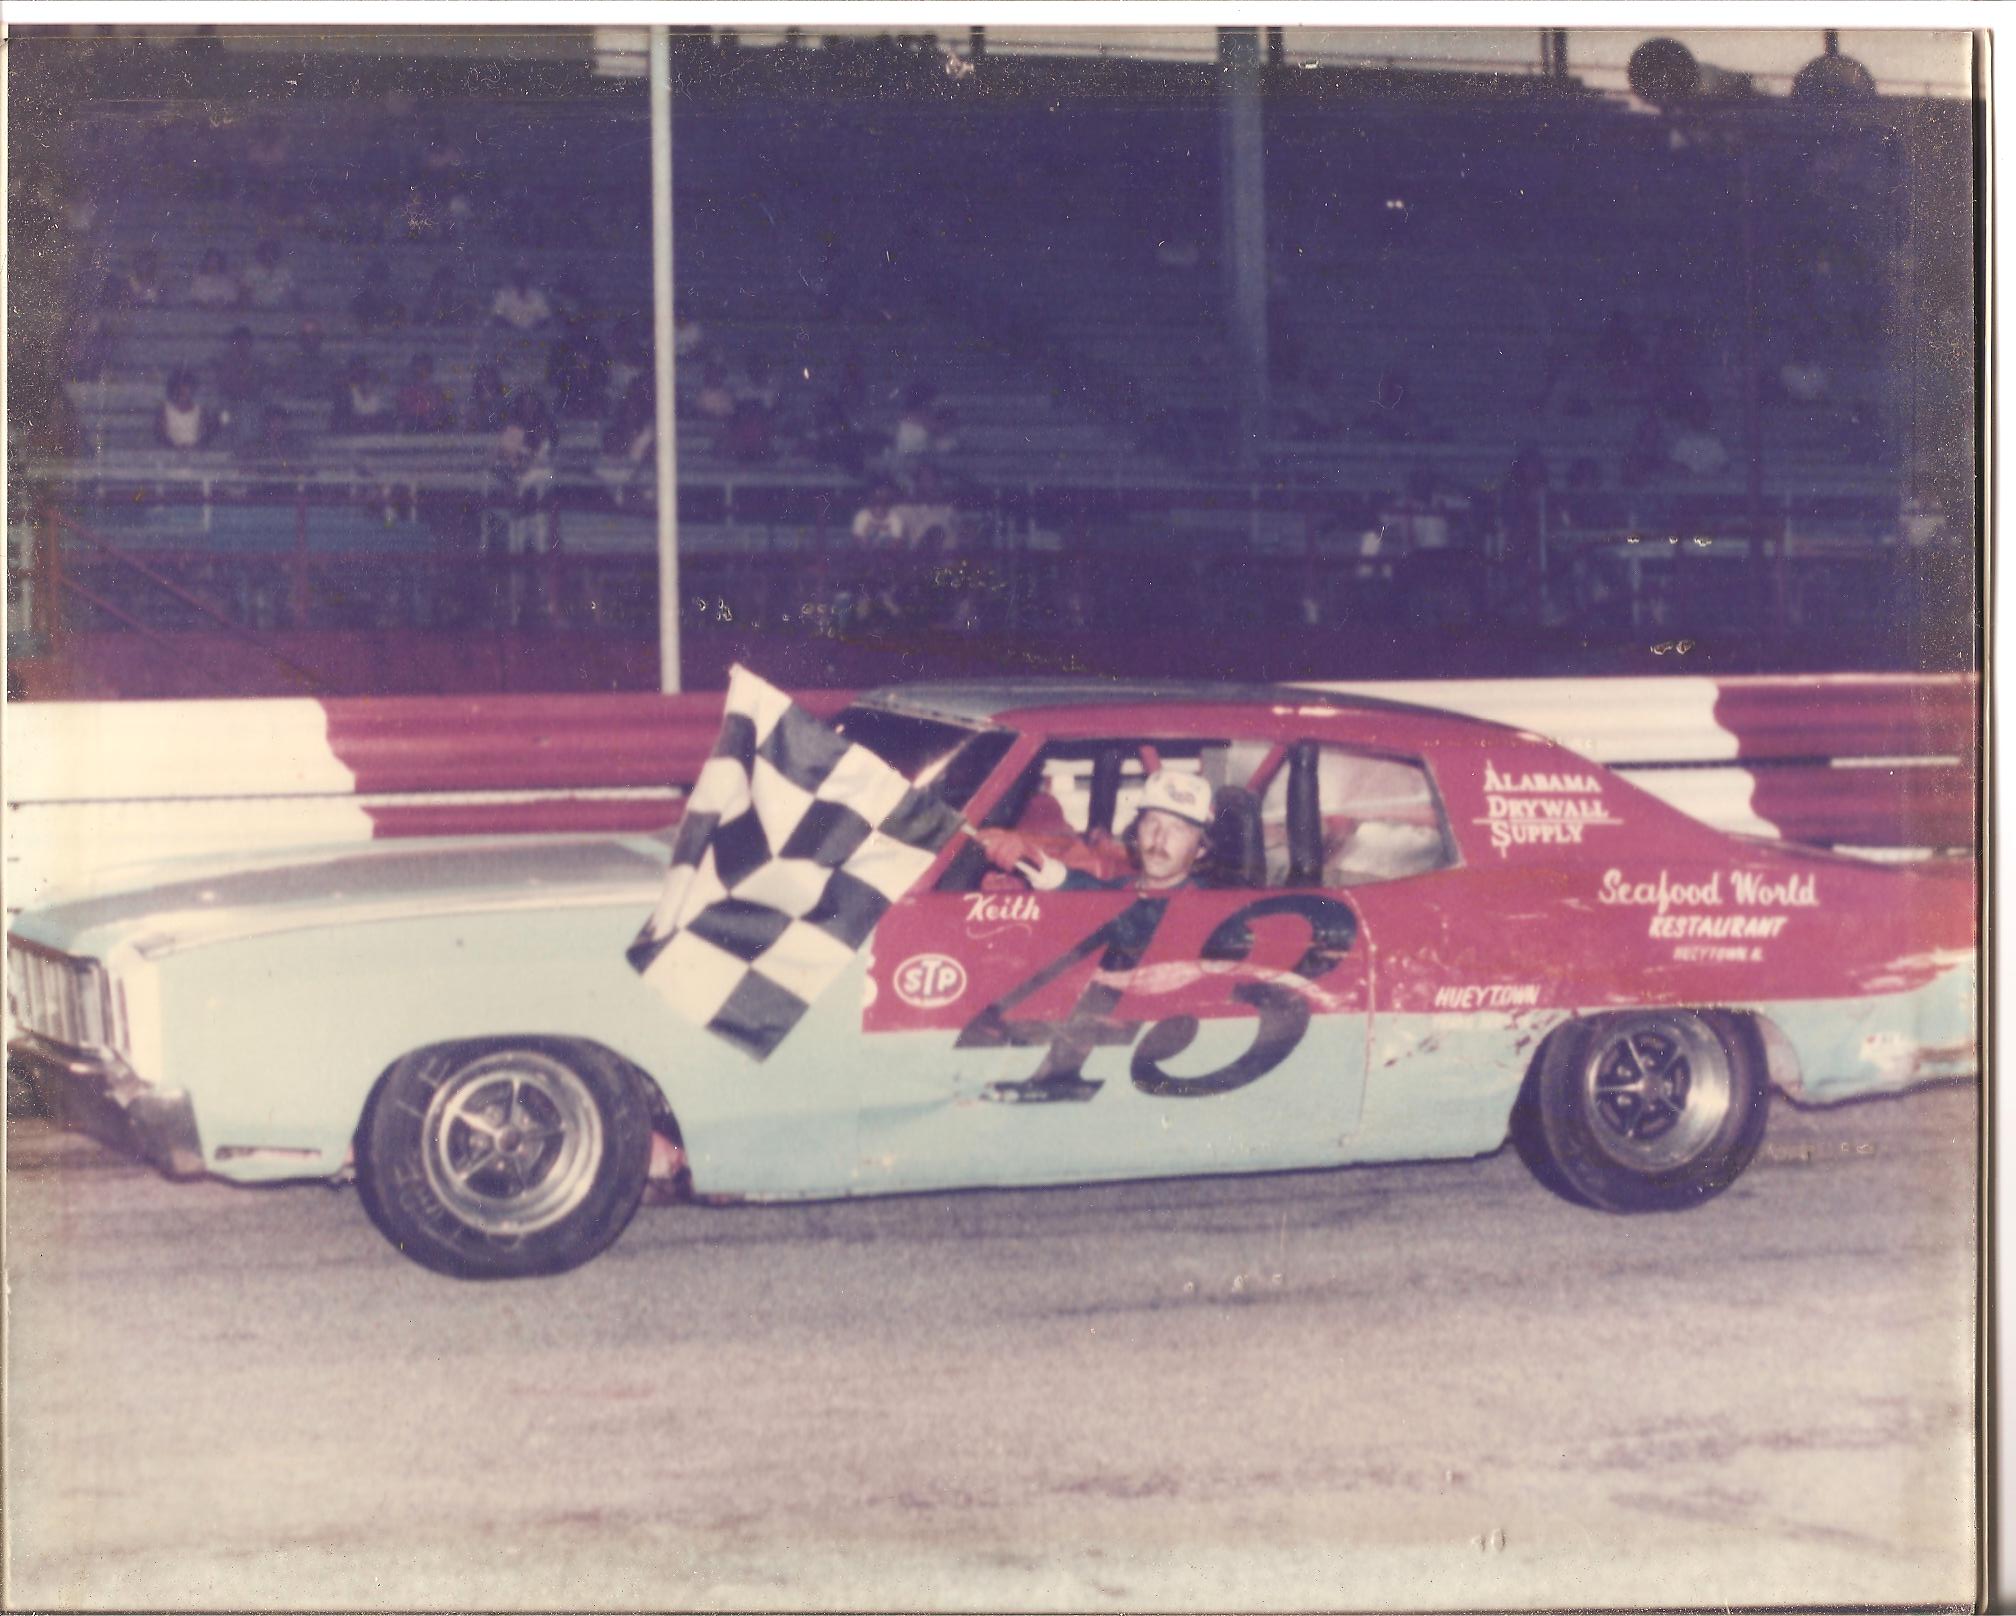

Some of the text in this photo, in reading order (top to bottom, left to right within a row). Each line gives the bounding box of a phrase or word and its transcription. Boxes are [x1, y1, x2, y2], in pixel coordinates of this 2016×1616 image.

[1484, 760, 1601, 792] ALABAMA
[1488, 796, 1609, 818] DRYWALL
[1491, 821, 1583, 859] SUPPLY
[963, 892, 1040, 921] Keith
[1599, 868, 1819, 914] Seafood World
[1649, 916, 1787, 938] RESTAURANT
[904, 959, 957, 996] STP
[953, 894, 1358, 1103] 43
[1435, 985, 1540, 1009] HUEYTOWN
